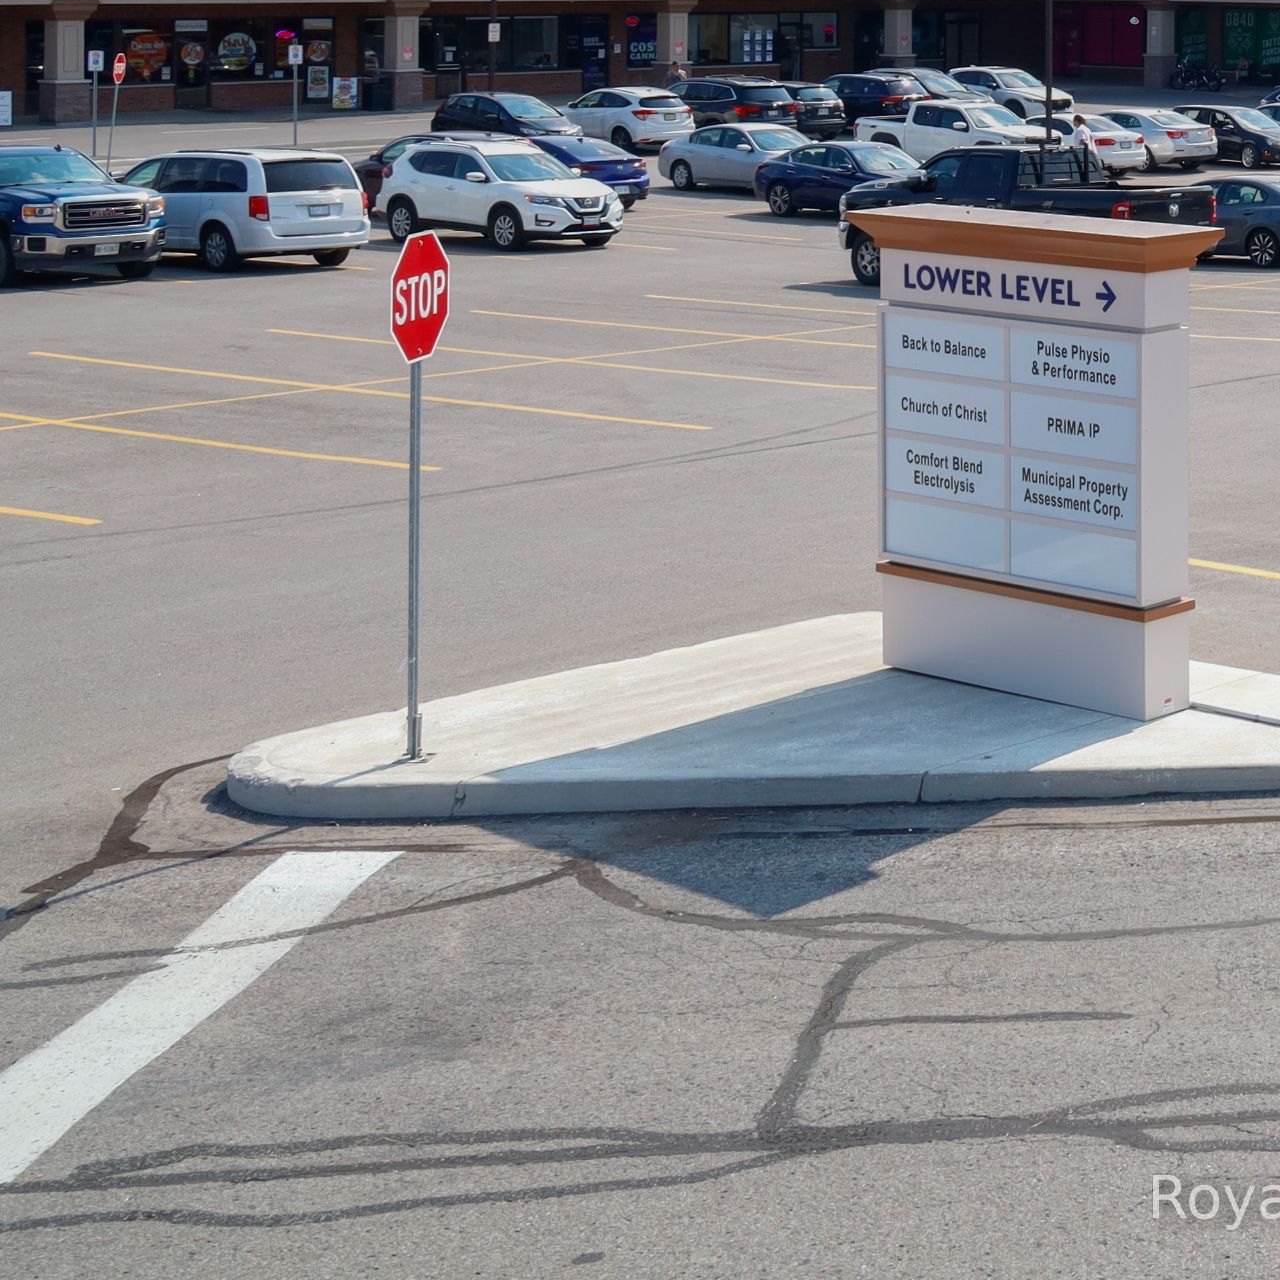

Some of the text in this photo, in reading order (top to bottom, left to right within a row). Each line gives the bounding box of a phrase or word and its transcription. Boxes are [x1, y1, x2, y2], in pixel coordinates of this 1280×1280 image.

[630, 41, 657, 53] COS
[395, 269, 446, 326] STOP
[903, 263, 1080, 307] LOWER LEVEL
[901, 334, 986, 359] Back to Balance
[1036, 341, 1110, 364] Pulse Physio
[1031, 360, 1117, 386] & Performance
[901, 396, 987, 423] Church of Christ
[1047, 417, 1100, 439] PRIMA IP
[906, 449, 983, 474] Comfort Blend
[913, 470, 975, 494] Electrolysis
[1021, 467, 1128, 500] Municipal Property
[1023, 488, 1124, 519] Assessment Corp.
